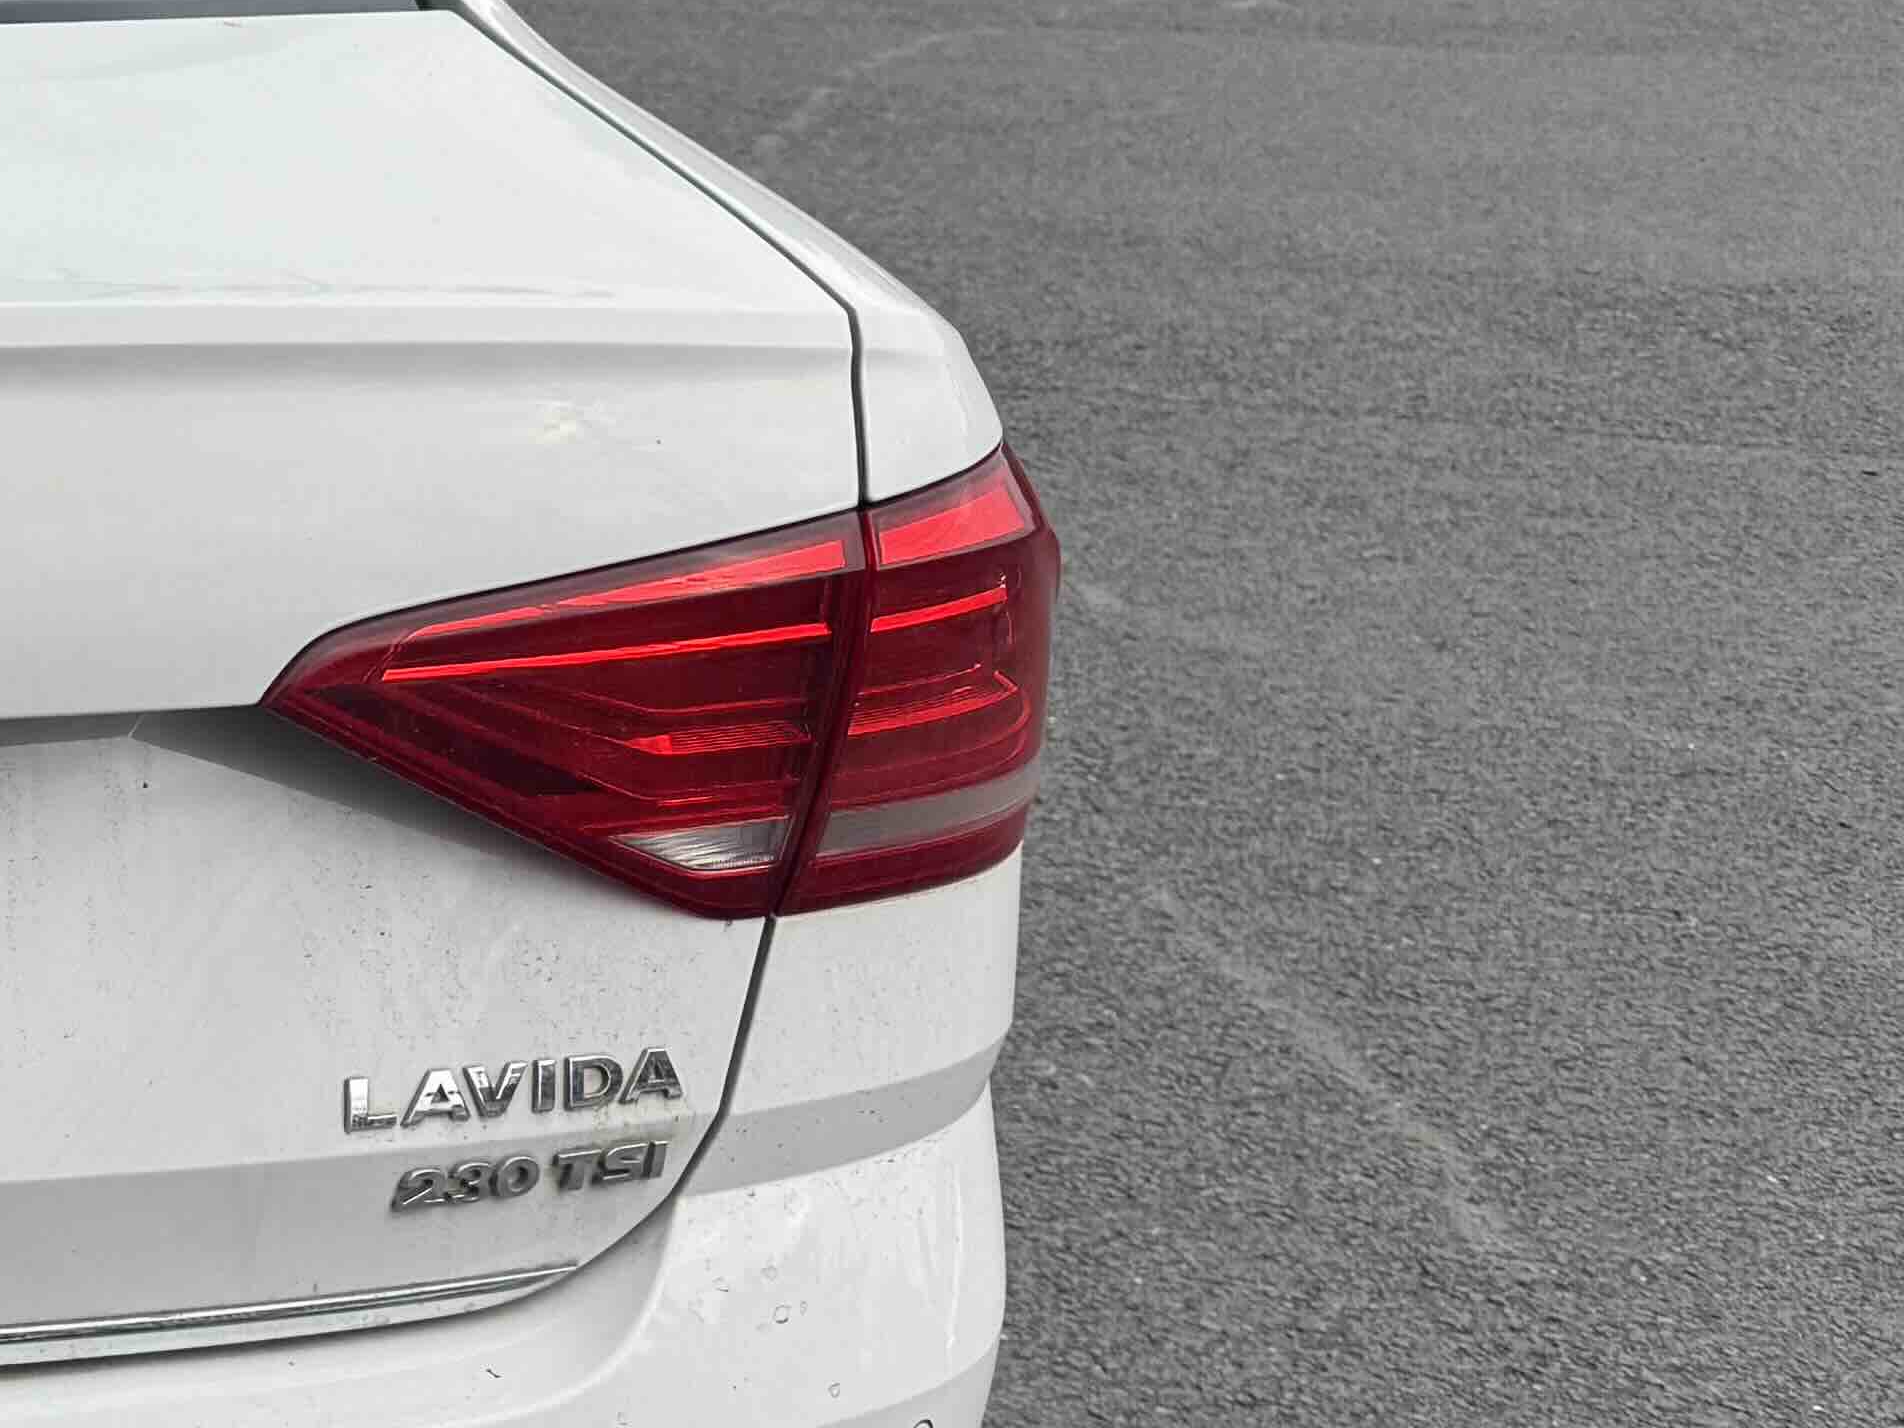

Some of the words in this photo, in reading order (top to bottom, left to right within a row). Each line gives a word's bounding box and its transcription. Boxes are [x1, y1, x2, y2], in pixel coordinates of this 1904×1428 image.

[342, 1046, 688, 1134] LAVIDA
[390, 1154, 540, 1213] 230
[553, 1138, 671, 1194] TSI
